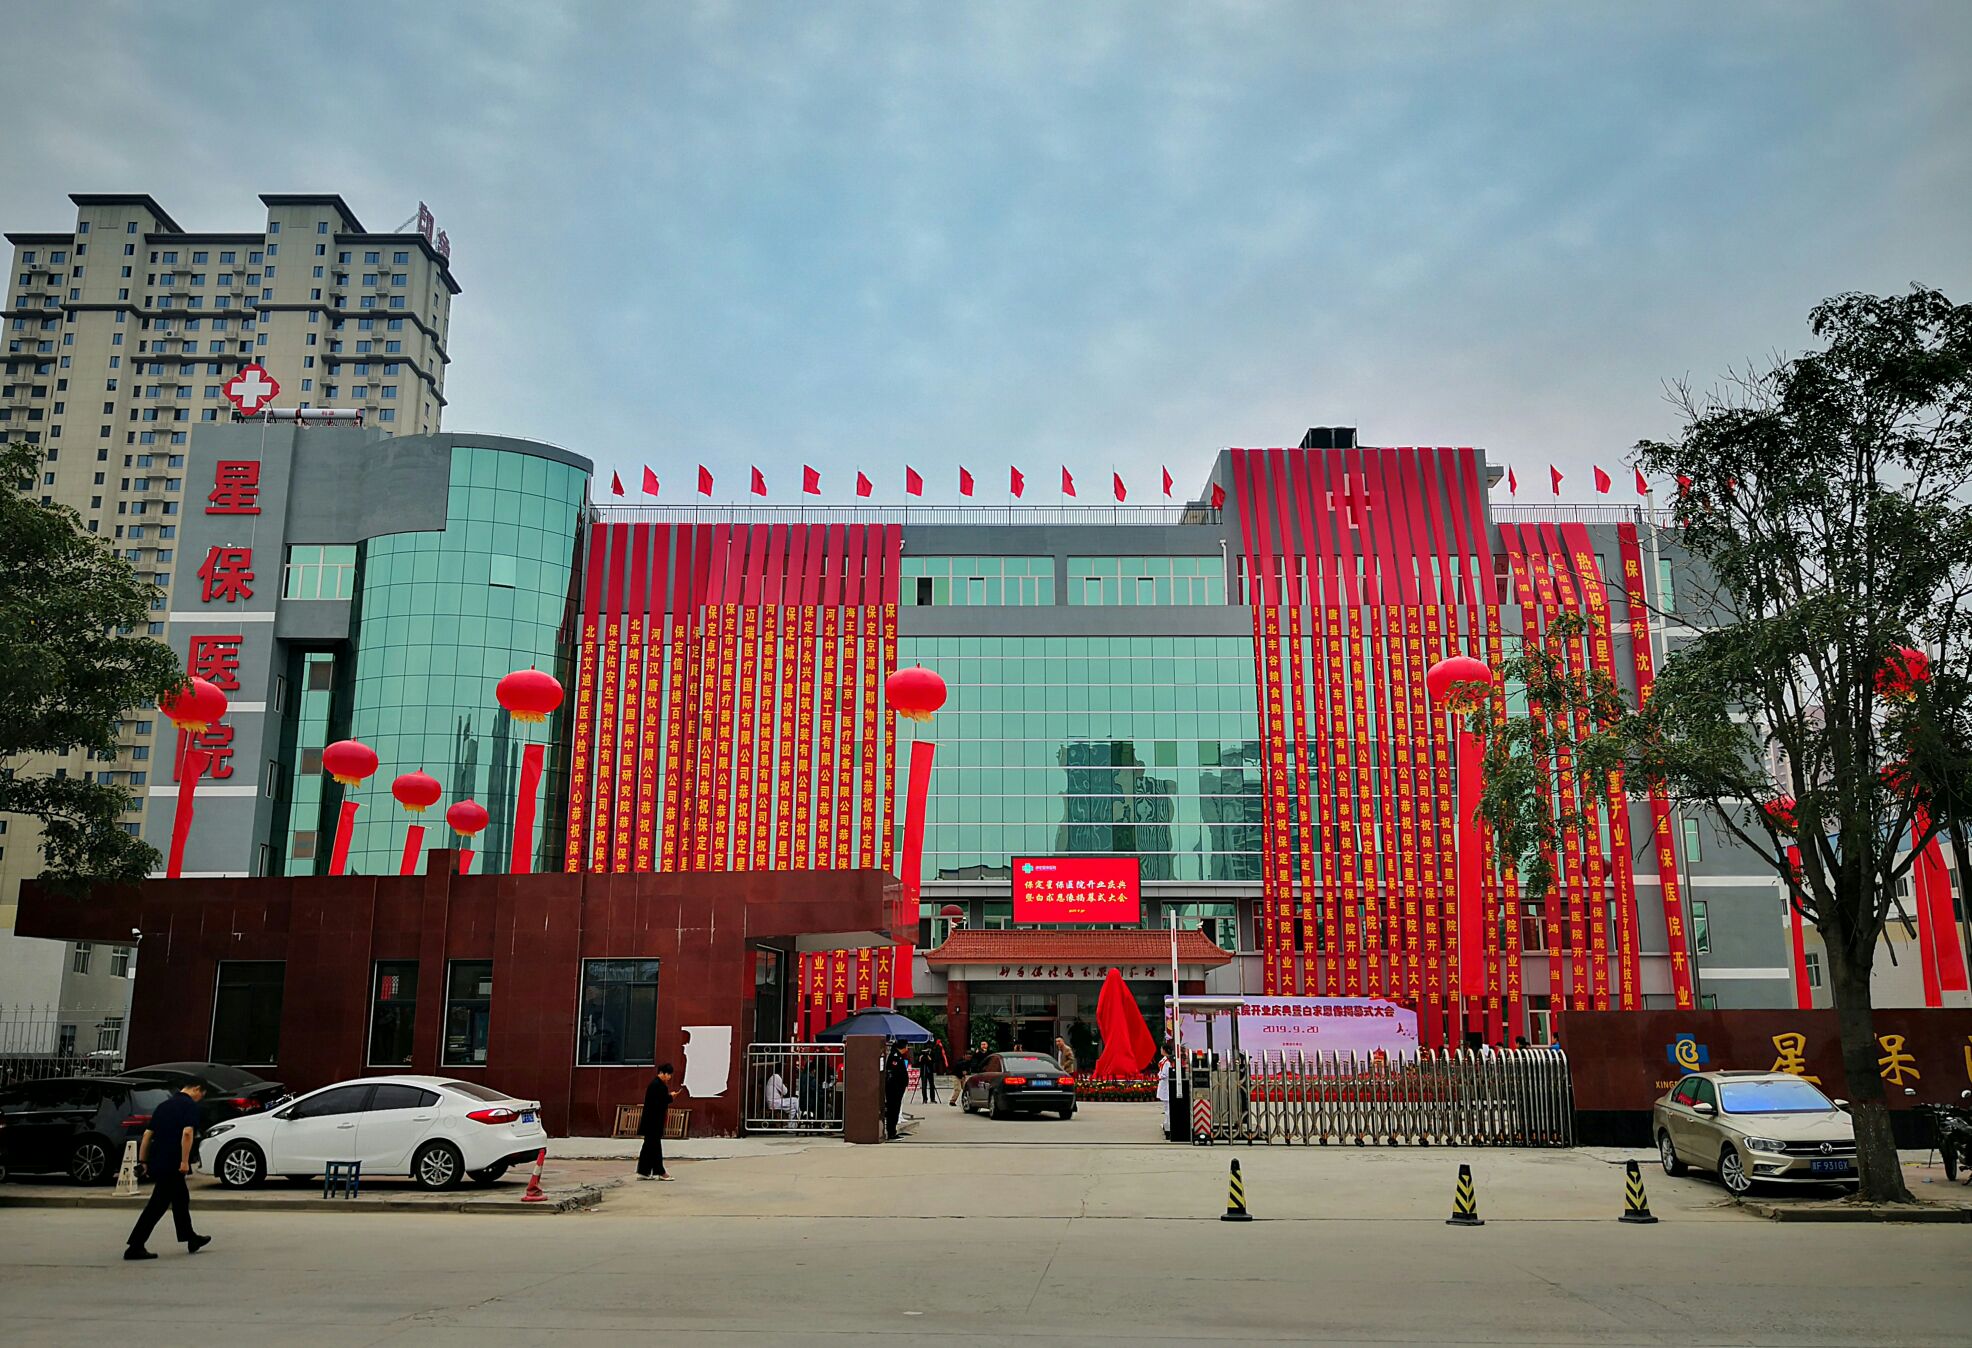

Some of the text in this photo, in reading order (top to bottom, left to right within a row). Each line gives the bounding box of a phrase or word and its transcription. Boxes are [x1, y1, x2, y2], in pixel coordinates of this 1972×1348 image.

[172, 460, 261, 781] 星保医院
[1024, 880, 1127, 889] 保定星保医院开业庆典
[1262, 1025, 1319, 1033] 2019.9.20
